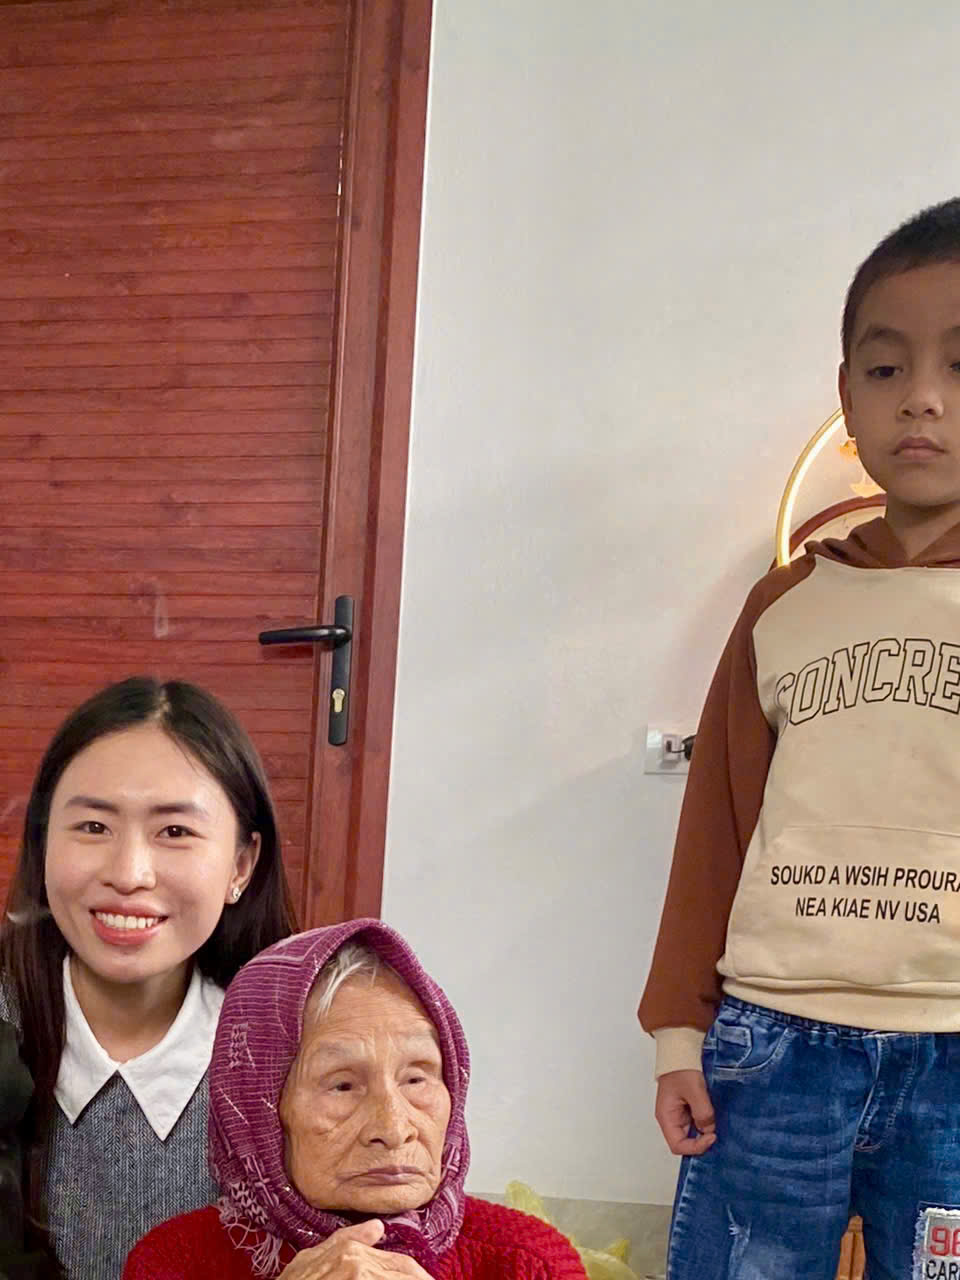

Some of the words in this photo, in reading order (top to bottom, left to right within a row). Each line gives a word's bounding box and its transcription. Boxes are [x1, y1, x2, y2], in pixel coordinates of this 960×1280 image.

[770, 864, 825, 886] SOUKD
[829, 865, 840, 886] A
[845, 865, 889, 888] WSIH
[795, 897, 827, 918] NEA
[831, 898, 871, 920] KIAE
[875, 900, 901, 922] NV
[904, 901, 941, 924] USA
